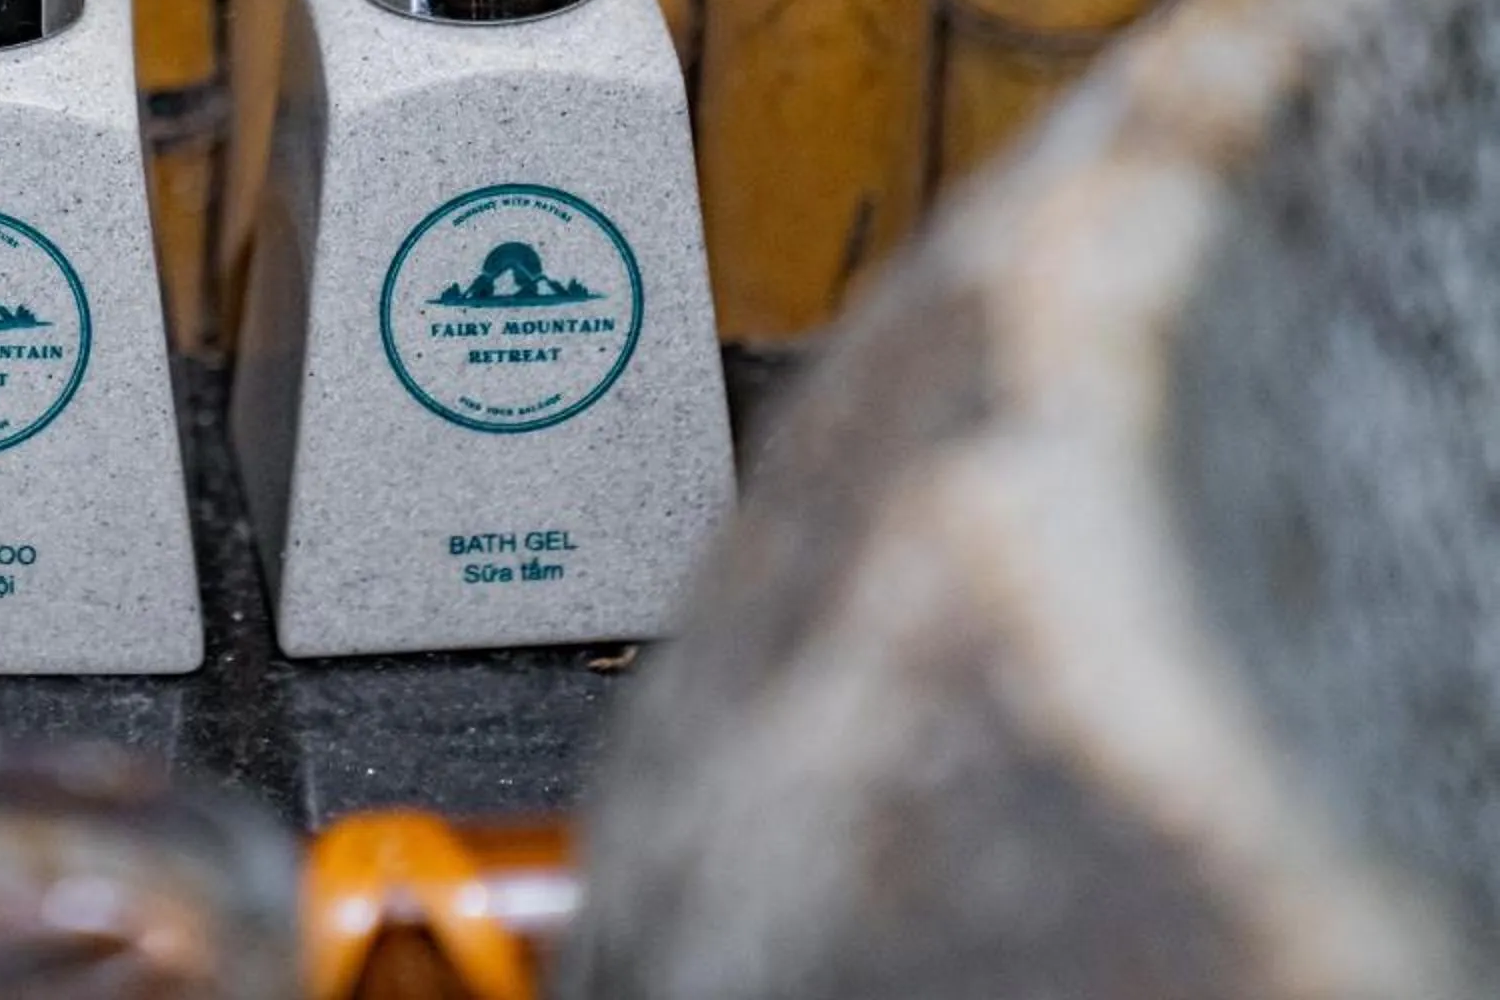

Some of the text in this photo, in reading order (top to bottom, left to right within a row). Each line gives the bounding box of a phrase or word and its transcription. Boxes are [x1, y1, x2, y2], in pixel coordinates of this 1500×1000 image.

[431, 318, 615, 337] FAIRY MOUNTAIN
[468, 347, 562, 364] RETREAT
[449, 530, 580, 555] BATH GEL
[463, 562, 513, 584] Sữa
